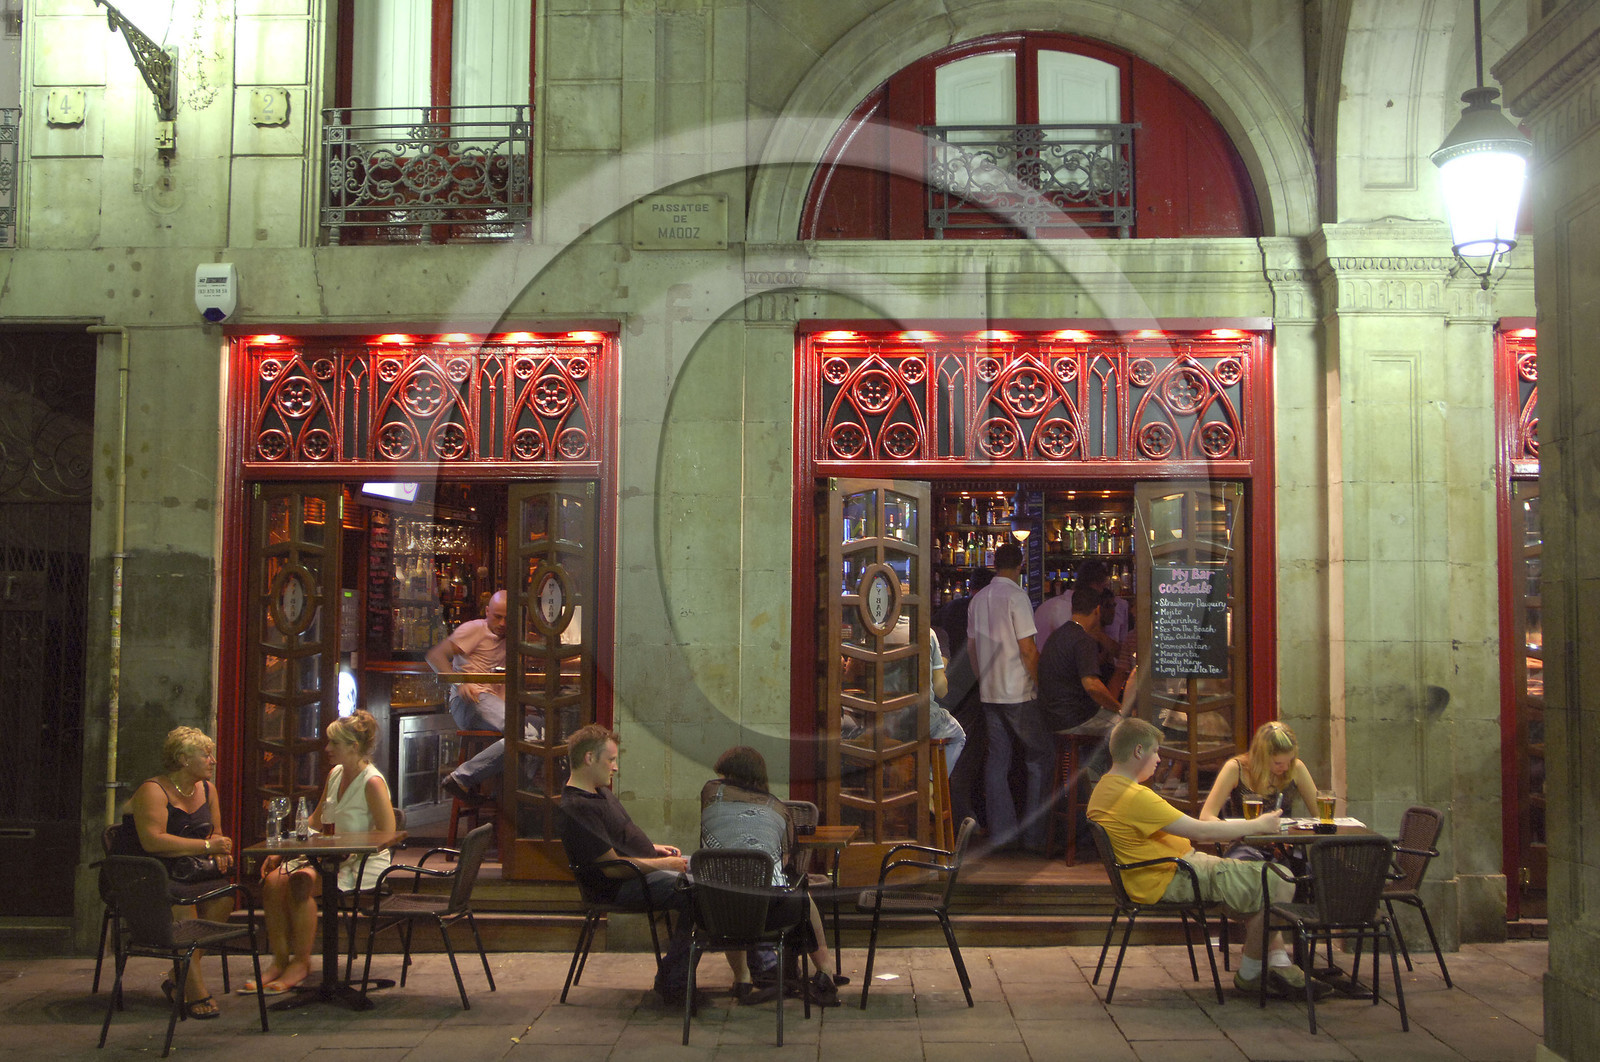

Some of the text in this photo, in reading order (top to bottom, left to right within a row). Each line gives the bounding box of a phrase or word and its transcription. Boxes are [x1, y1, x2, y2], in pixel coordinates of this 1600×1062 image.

[60, 95, 71, 114] 4
[263, 94, 274, 114] 2
[652, 203, 709, 212] PASSATGE
[673, 215, 688, 223] DE
[658, 227, 700, 239] MADOZ
[1172, 568, 1216, 583] My Bar
[1160, 598, 1195, 611] Strawberry
[1160, 608, 1182, 619] Mojito
[1160, 650, 1199, 658] Margarita
[1160, 665, 1176, 676] Long
